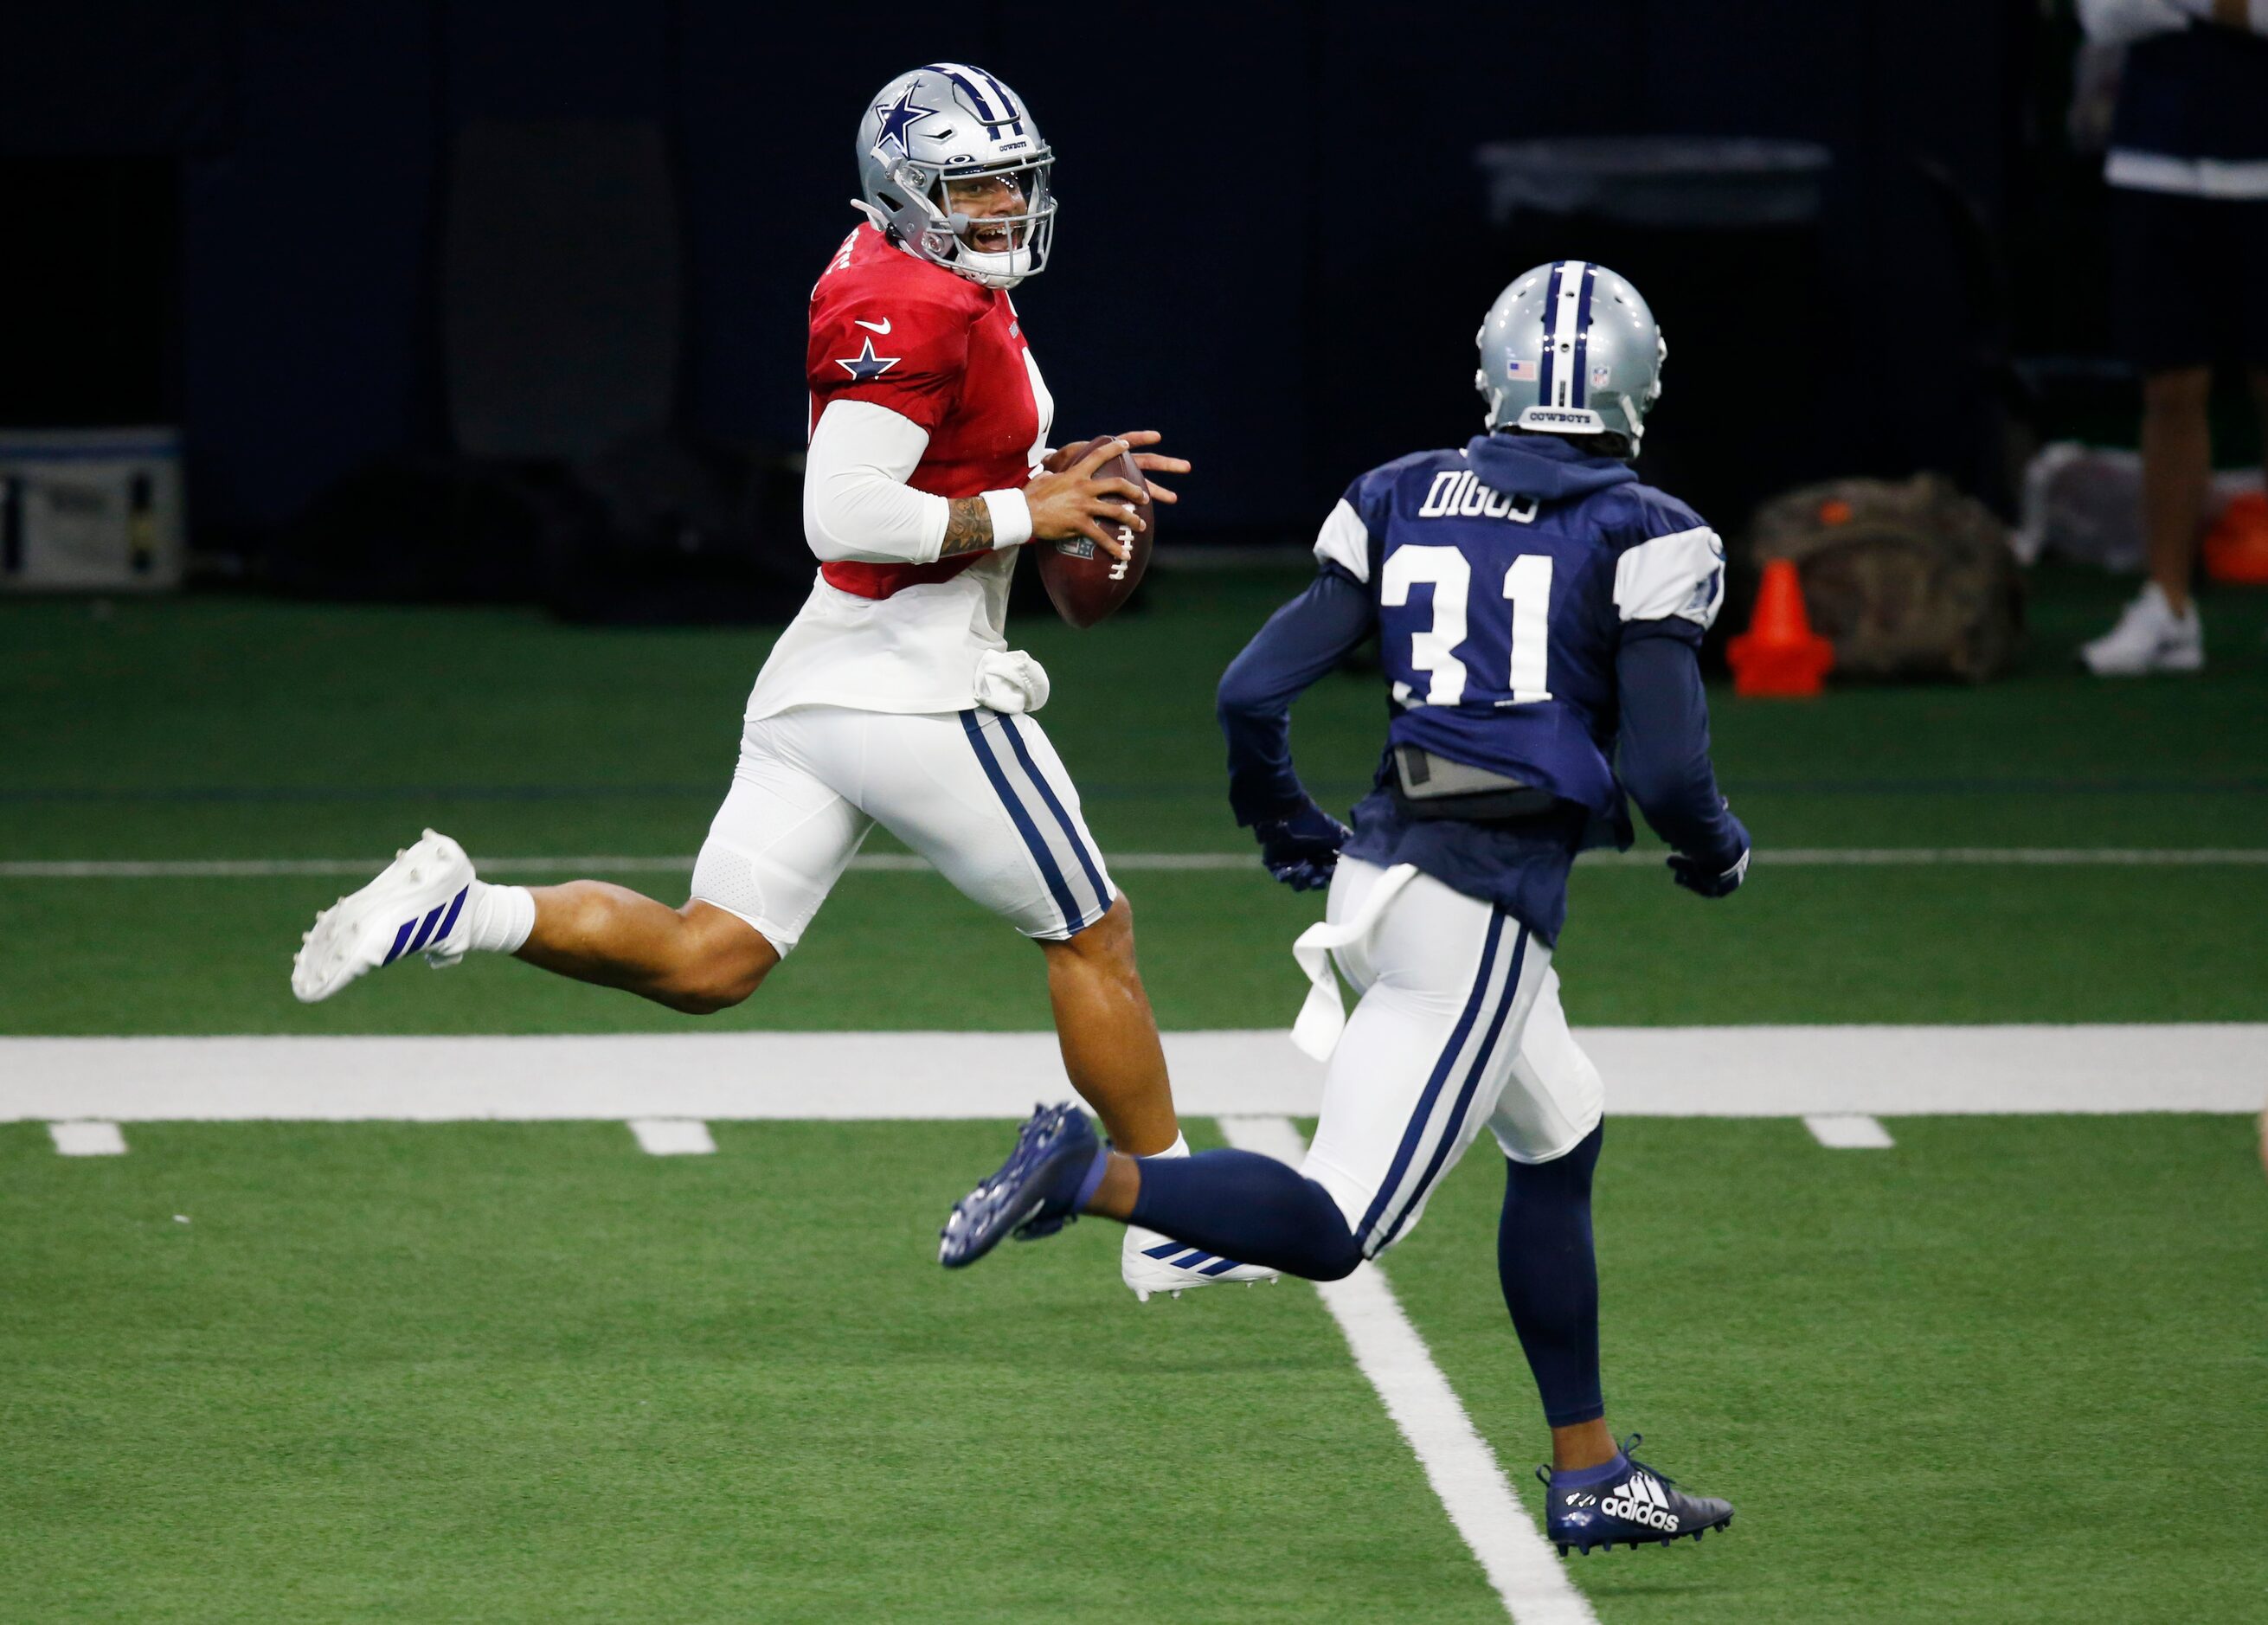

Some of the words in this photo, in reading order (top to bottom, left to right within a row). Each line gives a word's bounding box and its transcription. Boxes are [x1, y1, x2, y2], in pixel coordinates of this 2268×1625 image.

[1530, 412, 1590, 423] COWBOYS
[1381, 544, 1552, 709] 31
[1602, 1497, 1679, 1532] adidas
